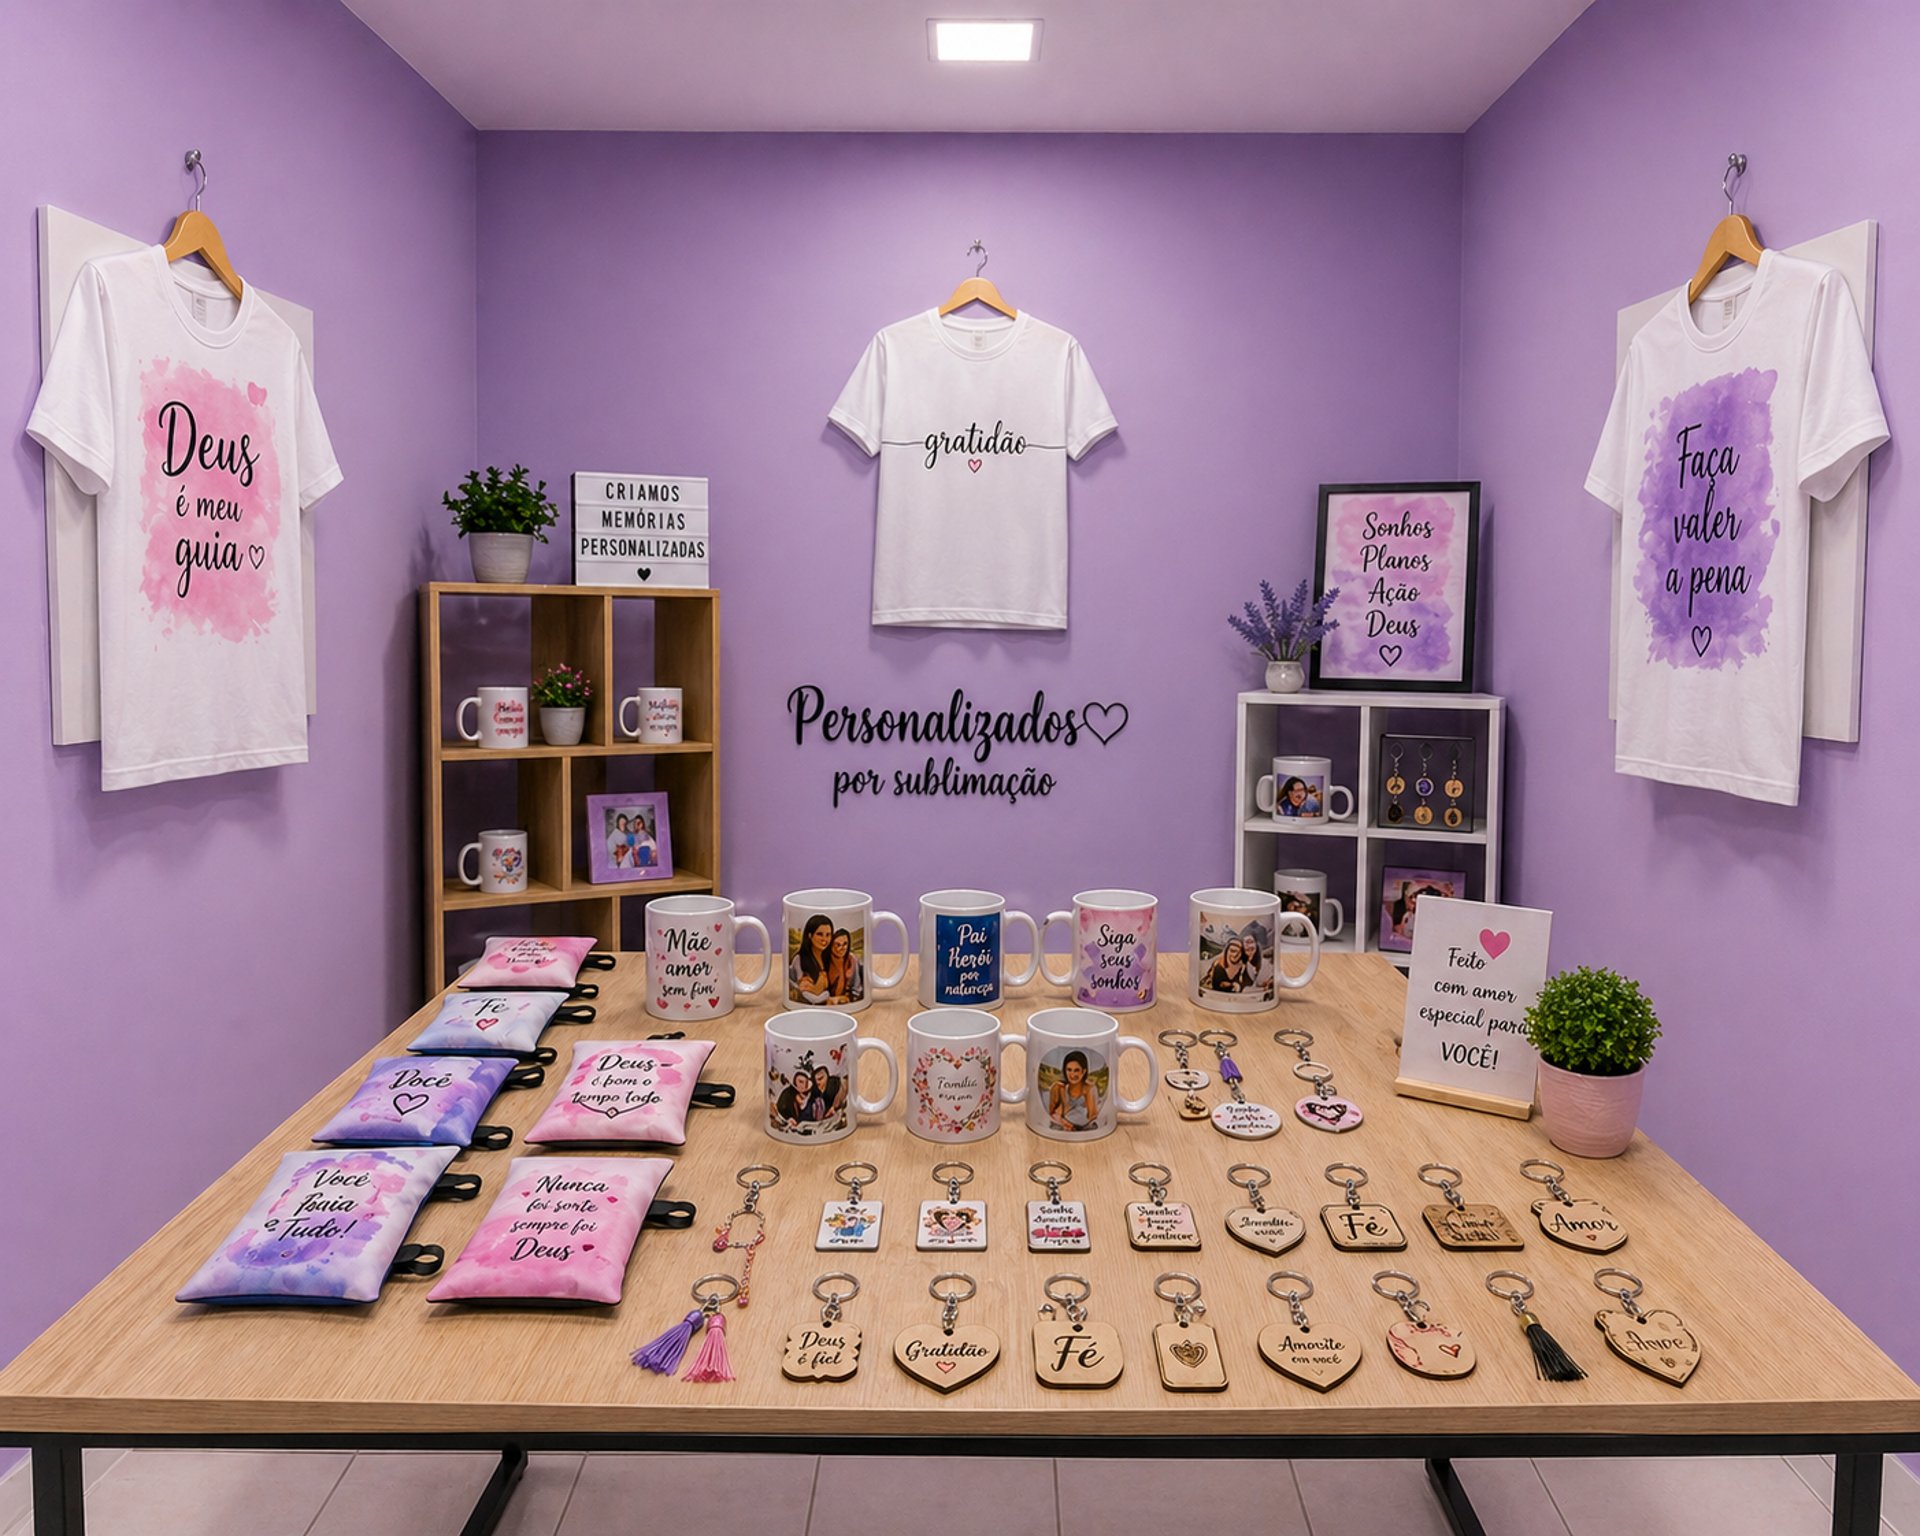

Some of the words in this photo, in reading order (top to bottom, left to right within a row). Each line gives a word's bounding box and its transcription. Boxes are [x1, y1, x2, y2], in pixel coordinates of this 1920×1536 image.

[158, 400, 260, 487] Deus
[925, 420, 1027, 470] gratidão
[1676, 424, 1740, 488] Faça
[176, 485, 188, 518] é
[196, 498, 242, 522] meu
[606, 482, 680, 502] CRIAMOS
[602, 508, 686, 530] MEMÓRIAS
[1362, 511, 1434, 540] Sonhos
[1674, 484, 1742, 544] valer
[581, 538, 705, 558] PERSONALIZADAS
[1360, 544, 1431, 572] Planos
[175, 530, 243, 598] guia
[1368, 577, 1420, 607] Ação
[1666, 567, 1683, 593] a
[1689, 565, 1752, 618] pena
[1365, 609, 1421, 638] Deus
[787, 684, 1082, 763] Personalizados
[833, 769, 885, 809] por
[893, 757, 1056, 804] sublimação
[664, 928, 712, 957] Mãe
[957, 924, 987, 946] Pai
[1097, 924, 1136, 953] Siga
[665, 961, 713, 978] amor
[1100, 954, 1134, 969] seus
[1449, 947, 1487, 970] Feito
[662, 984, 687, 998] sem
[1090, 968, 1142, 990] sonhos
[1434, 980, 1468, 996] com
[1472, 986, 1518, 1004] amor
[1419, 1006, 1486, 1028] especial
[597, 1054, 657, 1073] Deus
[1441, 1042, 1500, 1070] VOCÊ!
[535, 1174, 609, 1194] Nunca
[553, 1199, 599, 1214] sorte
[509, 1219, 570, 1237] sempre
[570, 1218, 599, 1236] foi
[1550, 1212, 1619, 1234] Amor
[509, 1236, 576, 1262] Deus
[798, 1330, 847, 1350] Deus
[1050, 1334, 1105, 1373] Fé
